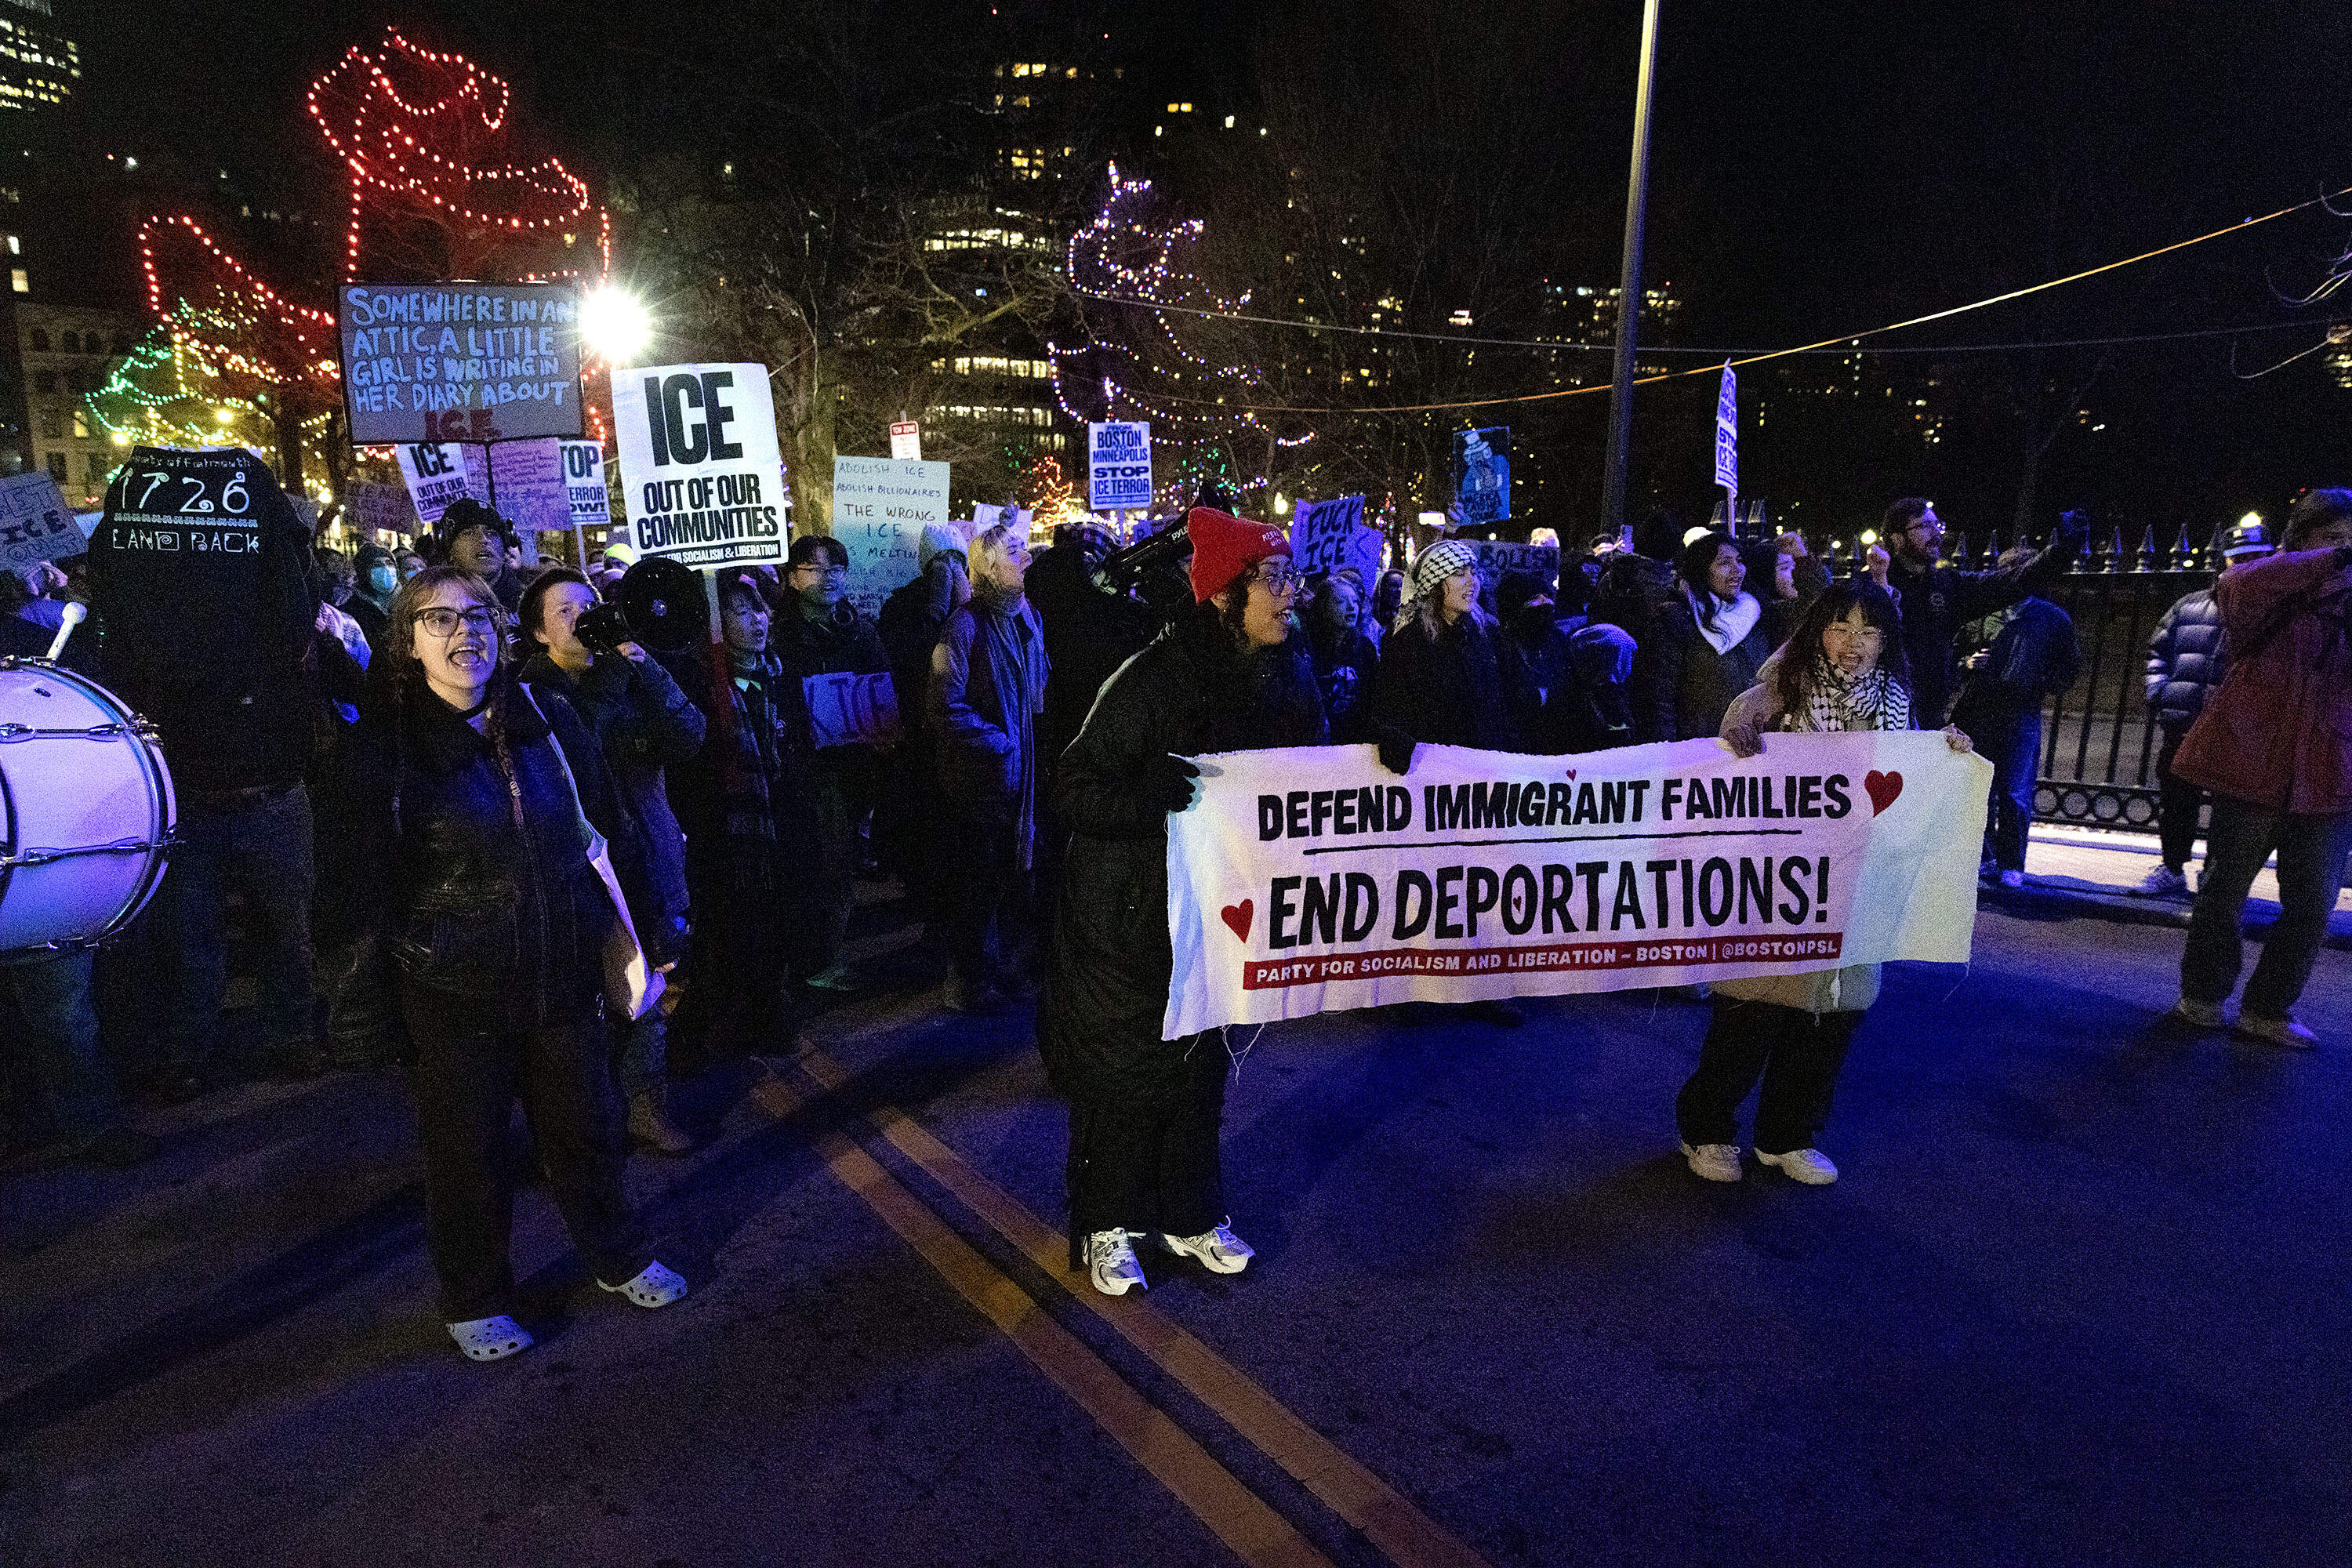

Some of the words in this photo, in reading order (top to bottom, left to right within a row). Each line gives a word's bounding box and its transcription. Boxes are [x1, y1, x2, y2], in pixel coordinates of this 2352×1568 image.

[347, 288, 506, 325] SOMEWHERE
[510, 299, 538, 322] IN
[541, 299, 579, 323] AN
[468, 326, 555, 358] LITTLE
[353, 358, 412, 387] GIRL
[416, 357, 437, 381] IS
[443, 357, 535, 382] WRITING
[539, 358, 560, 376] IN
[353, 383, 404, 412] HER
[412, 383, 474, 412] DIARY
[481, 381, 570, 410] ABOUT
[424, 408, 502, 441] ICE
[644, 371, 743, 466] ICE
[1098, 430, 1142, 448] BOSTON
[409, 441, 455, 478] ICE
[560, 445, 600, 480] TOP
[838, 462, 890, 474] ABOLISH
[905, 466, 926, 478] ICE
[1093, 448, 1149, 463] MINNEAPOLIS
[1094, 466, 1149, 478] STOP
[1094, 480, 1109, 495] ICE
[1111, 478, 1149, 494] TERROR
[118, 467, 250, 514] 1726
[416, 484, 434, 499] OUT
[434, 481, 445, 495] OF
[446, 477, 466, 492] OUR
[568, 486, 604, 501] ERROR
[643, 478, 684, 515] OUT
[688, 477, 714, 509] OF
[717, 474, 761, 506] OUR
[837, 482, 873, 493] ABOLISH
[877, 485, 942, 498] BILLIONAIRES
[844, 503, 874, 517] THE
[886, 506, 935, 521] WRONG
[1307, 500, 1361, 543] FUCK
[112, 528, 180, 551] LAND
[191, 531, 260, 554] BACK
[637, 506, 779, 550] COMMUNITIES
[867, 523, 902, 538] ICE
[684, 546, 724, 563] SOCIALISM
[725, 547, 735, 559] &
[735, 543, 779, 558] LIBERATION
[868, 547, 918, 560] MELTIN
[1302, 535, 1348, 572] ICE
[1257, 783, 1412, 842] DEFEND
[1424, 778, 1650, 833] IMMIGRANT
[1661, 773, 1852, 822] FAMILIES
[1269, 871, 1380, 950] END
[1392, 855, 1829, 942] DEPORTATIONS!
[1256, 962, 1316, 983] PARTY
[1321, 959, 1356, 977] FOR
[1359, 954, 1461, 974] SOCIALISM
[1465, 953, 1501, 971] AND
[1507, 948, 1617, 968] LIBERATION
[1635, 944, 1708, 963] BOSTON
[1722, 939, 1838, 960] @BOSTONPSL
